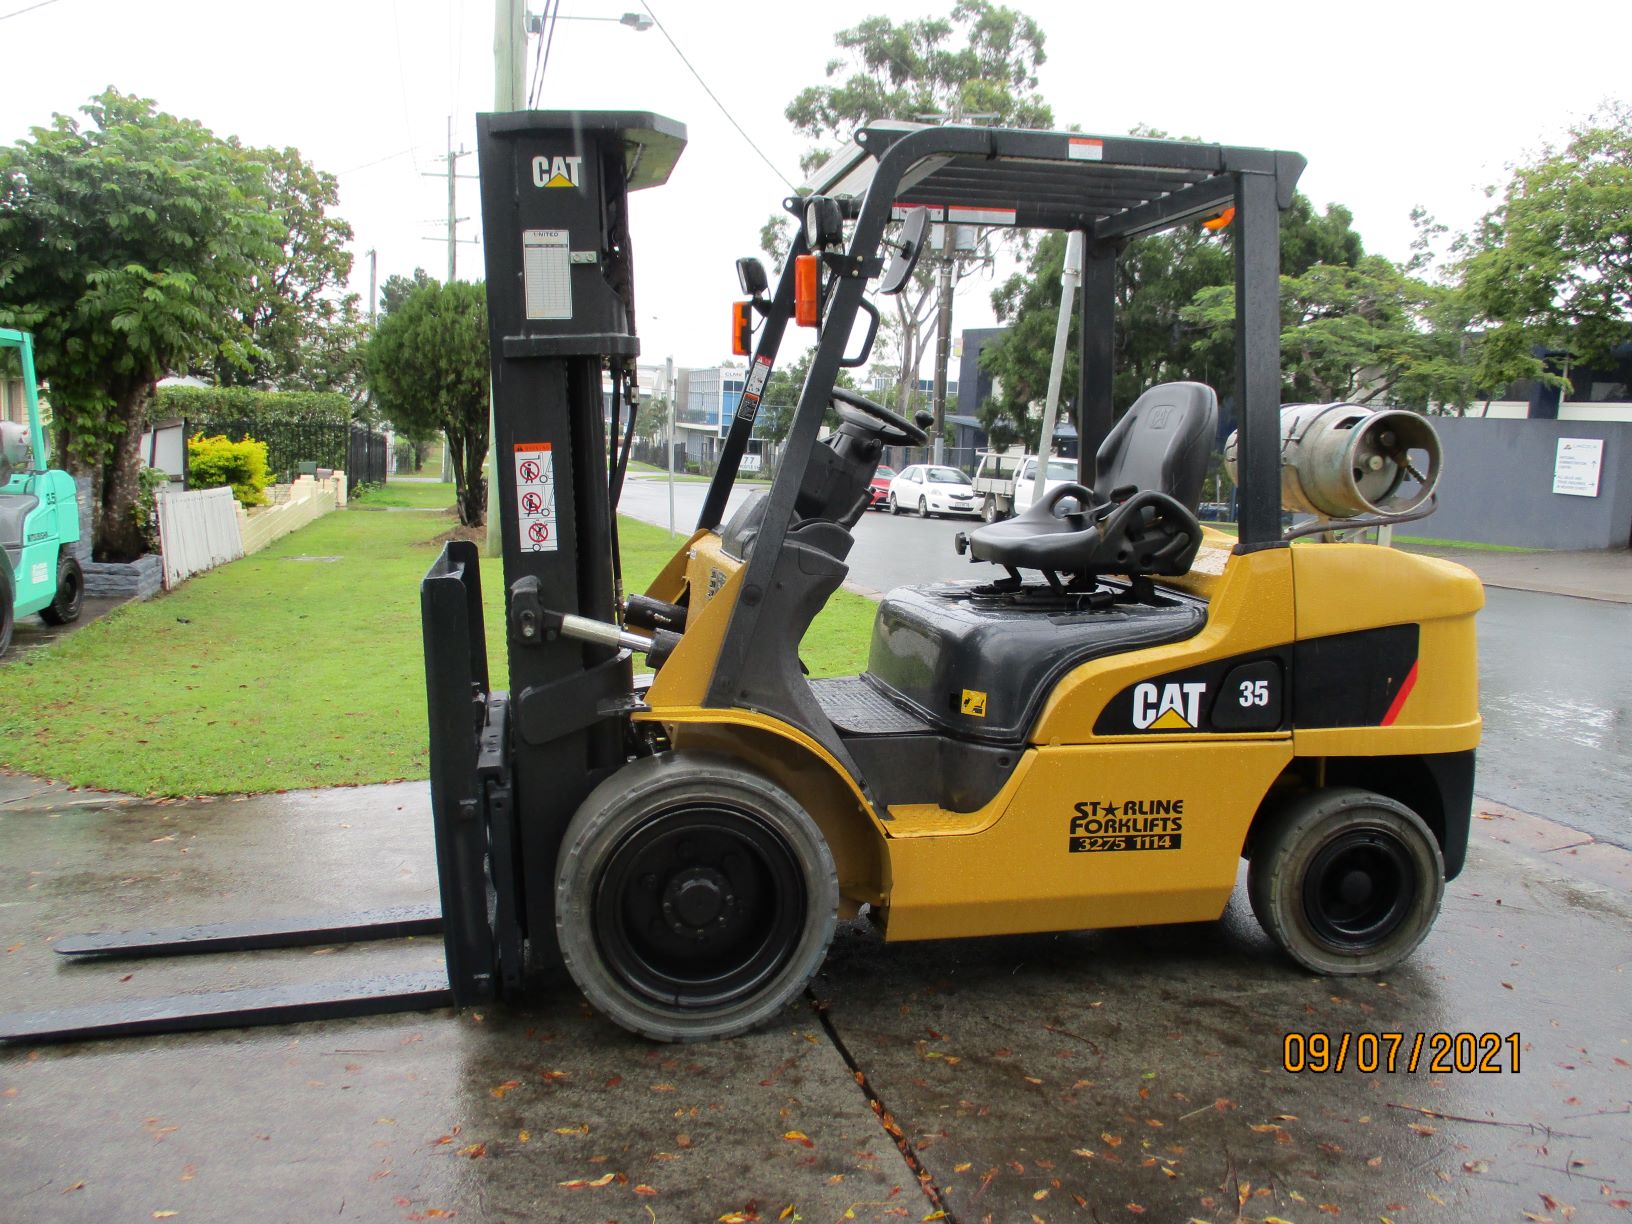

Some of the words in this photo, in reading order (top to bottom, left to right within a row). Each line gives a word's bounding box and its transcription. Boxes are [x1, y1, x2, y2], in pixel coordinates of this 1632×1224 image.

[532, 156, 582, 188] CAT
[744, 456, 755, 464] 77
[1239, 680, 1269, 707] 35
[1132, 682, 1206, 730] CAT
[1070, 816, 1183, 835] FORKLIFTS
[1079, 837, 1126, 851] 3275
[1133, 835, 1172, 848] 1114
